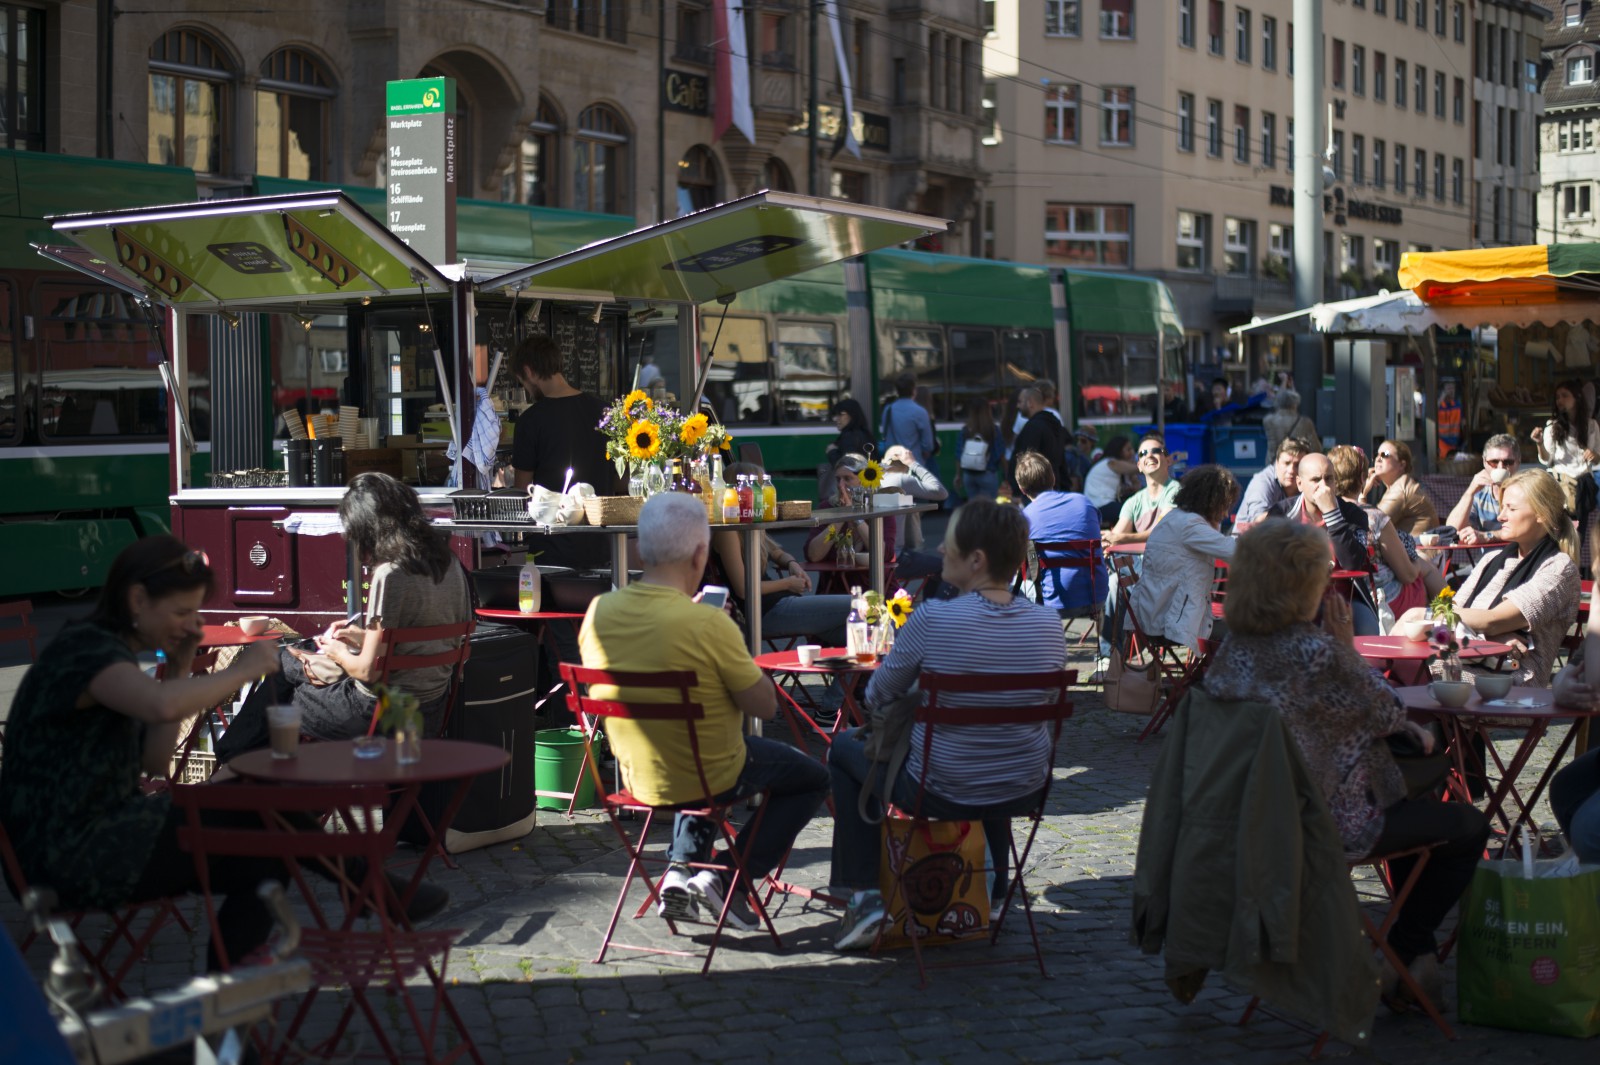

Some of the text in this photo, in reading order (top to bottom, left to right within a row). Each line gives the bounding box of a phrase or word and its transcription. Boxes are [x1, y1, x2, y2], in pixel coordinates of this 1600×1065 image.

[391, 120, 422, 130] Marktplatz
[390, 146, 401, 158] 14
[447, 118, 455, 183] Marktplatz
[391, 158, 423, 167] Messeplatz
[391, 166, 437, 177] Dreirosenbrücke
[390, 183, 401, 195] 16
[391, 195, 423, 205] Schifflände
[390, 211, 401, 223] 17
[391, 223, 426, 233] Wiesenplatz
[1535, 922, 1568, 938] EIN,
